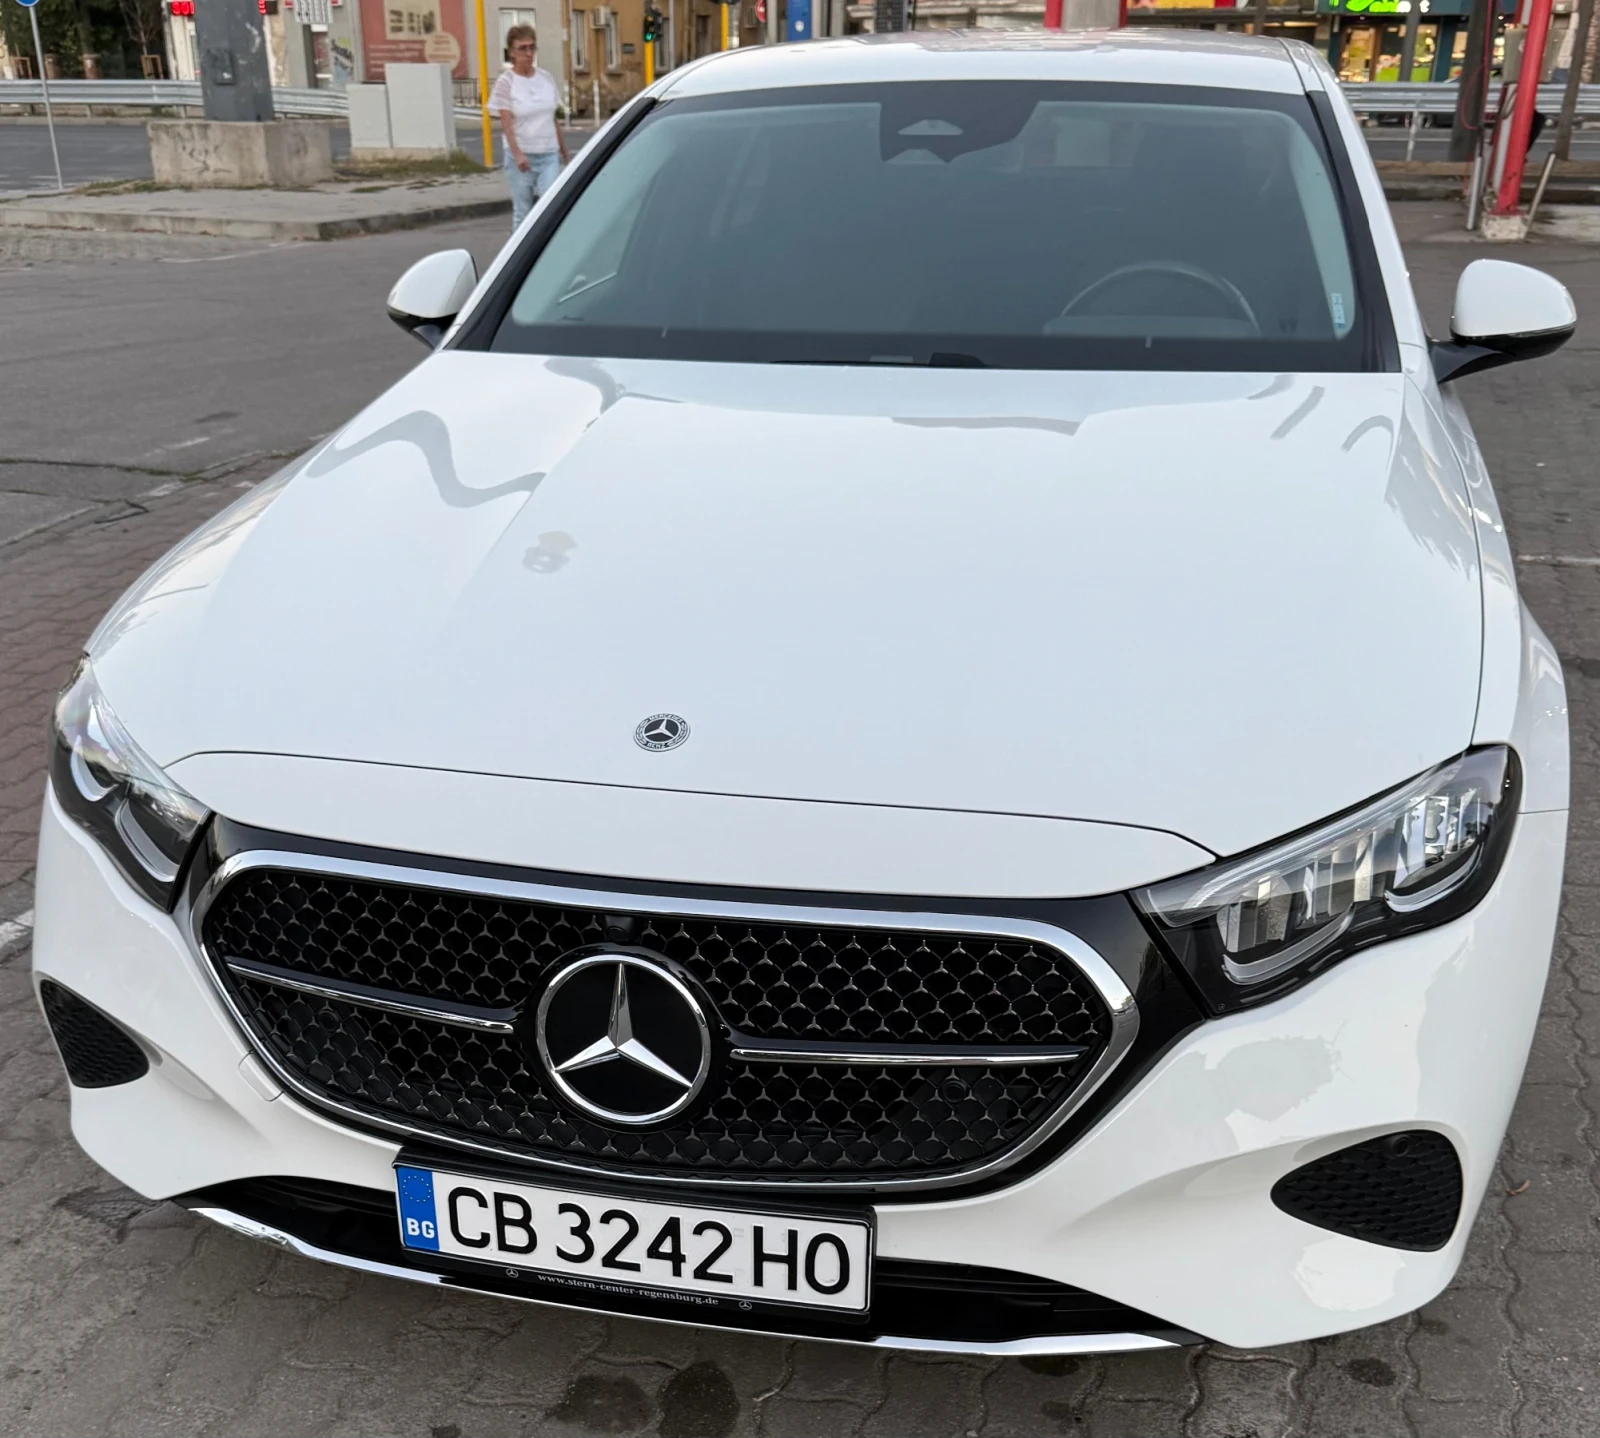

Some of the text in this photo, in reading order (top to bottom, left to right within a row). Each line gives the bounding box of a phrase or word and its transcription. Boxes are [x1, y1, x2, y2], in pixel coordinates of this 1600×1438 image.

[406, 1217, 435, 1239] BG
[448, 1186, 850, 1295] CB 3242 HO
[537, 1273, 719, 1305] www.stern-center-regensburg.de
